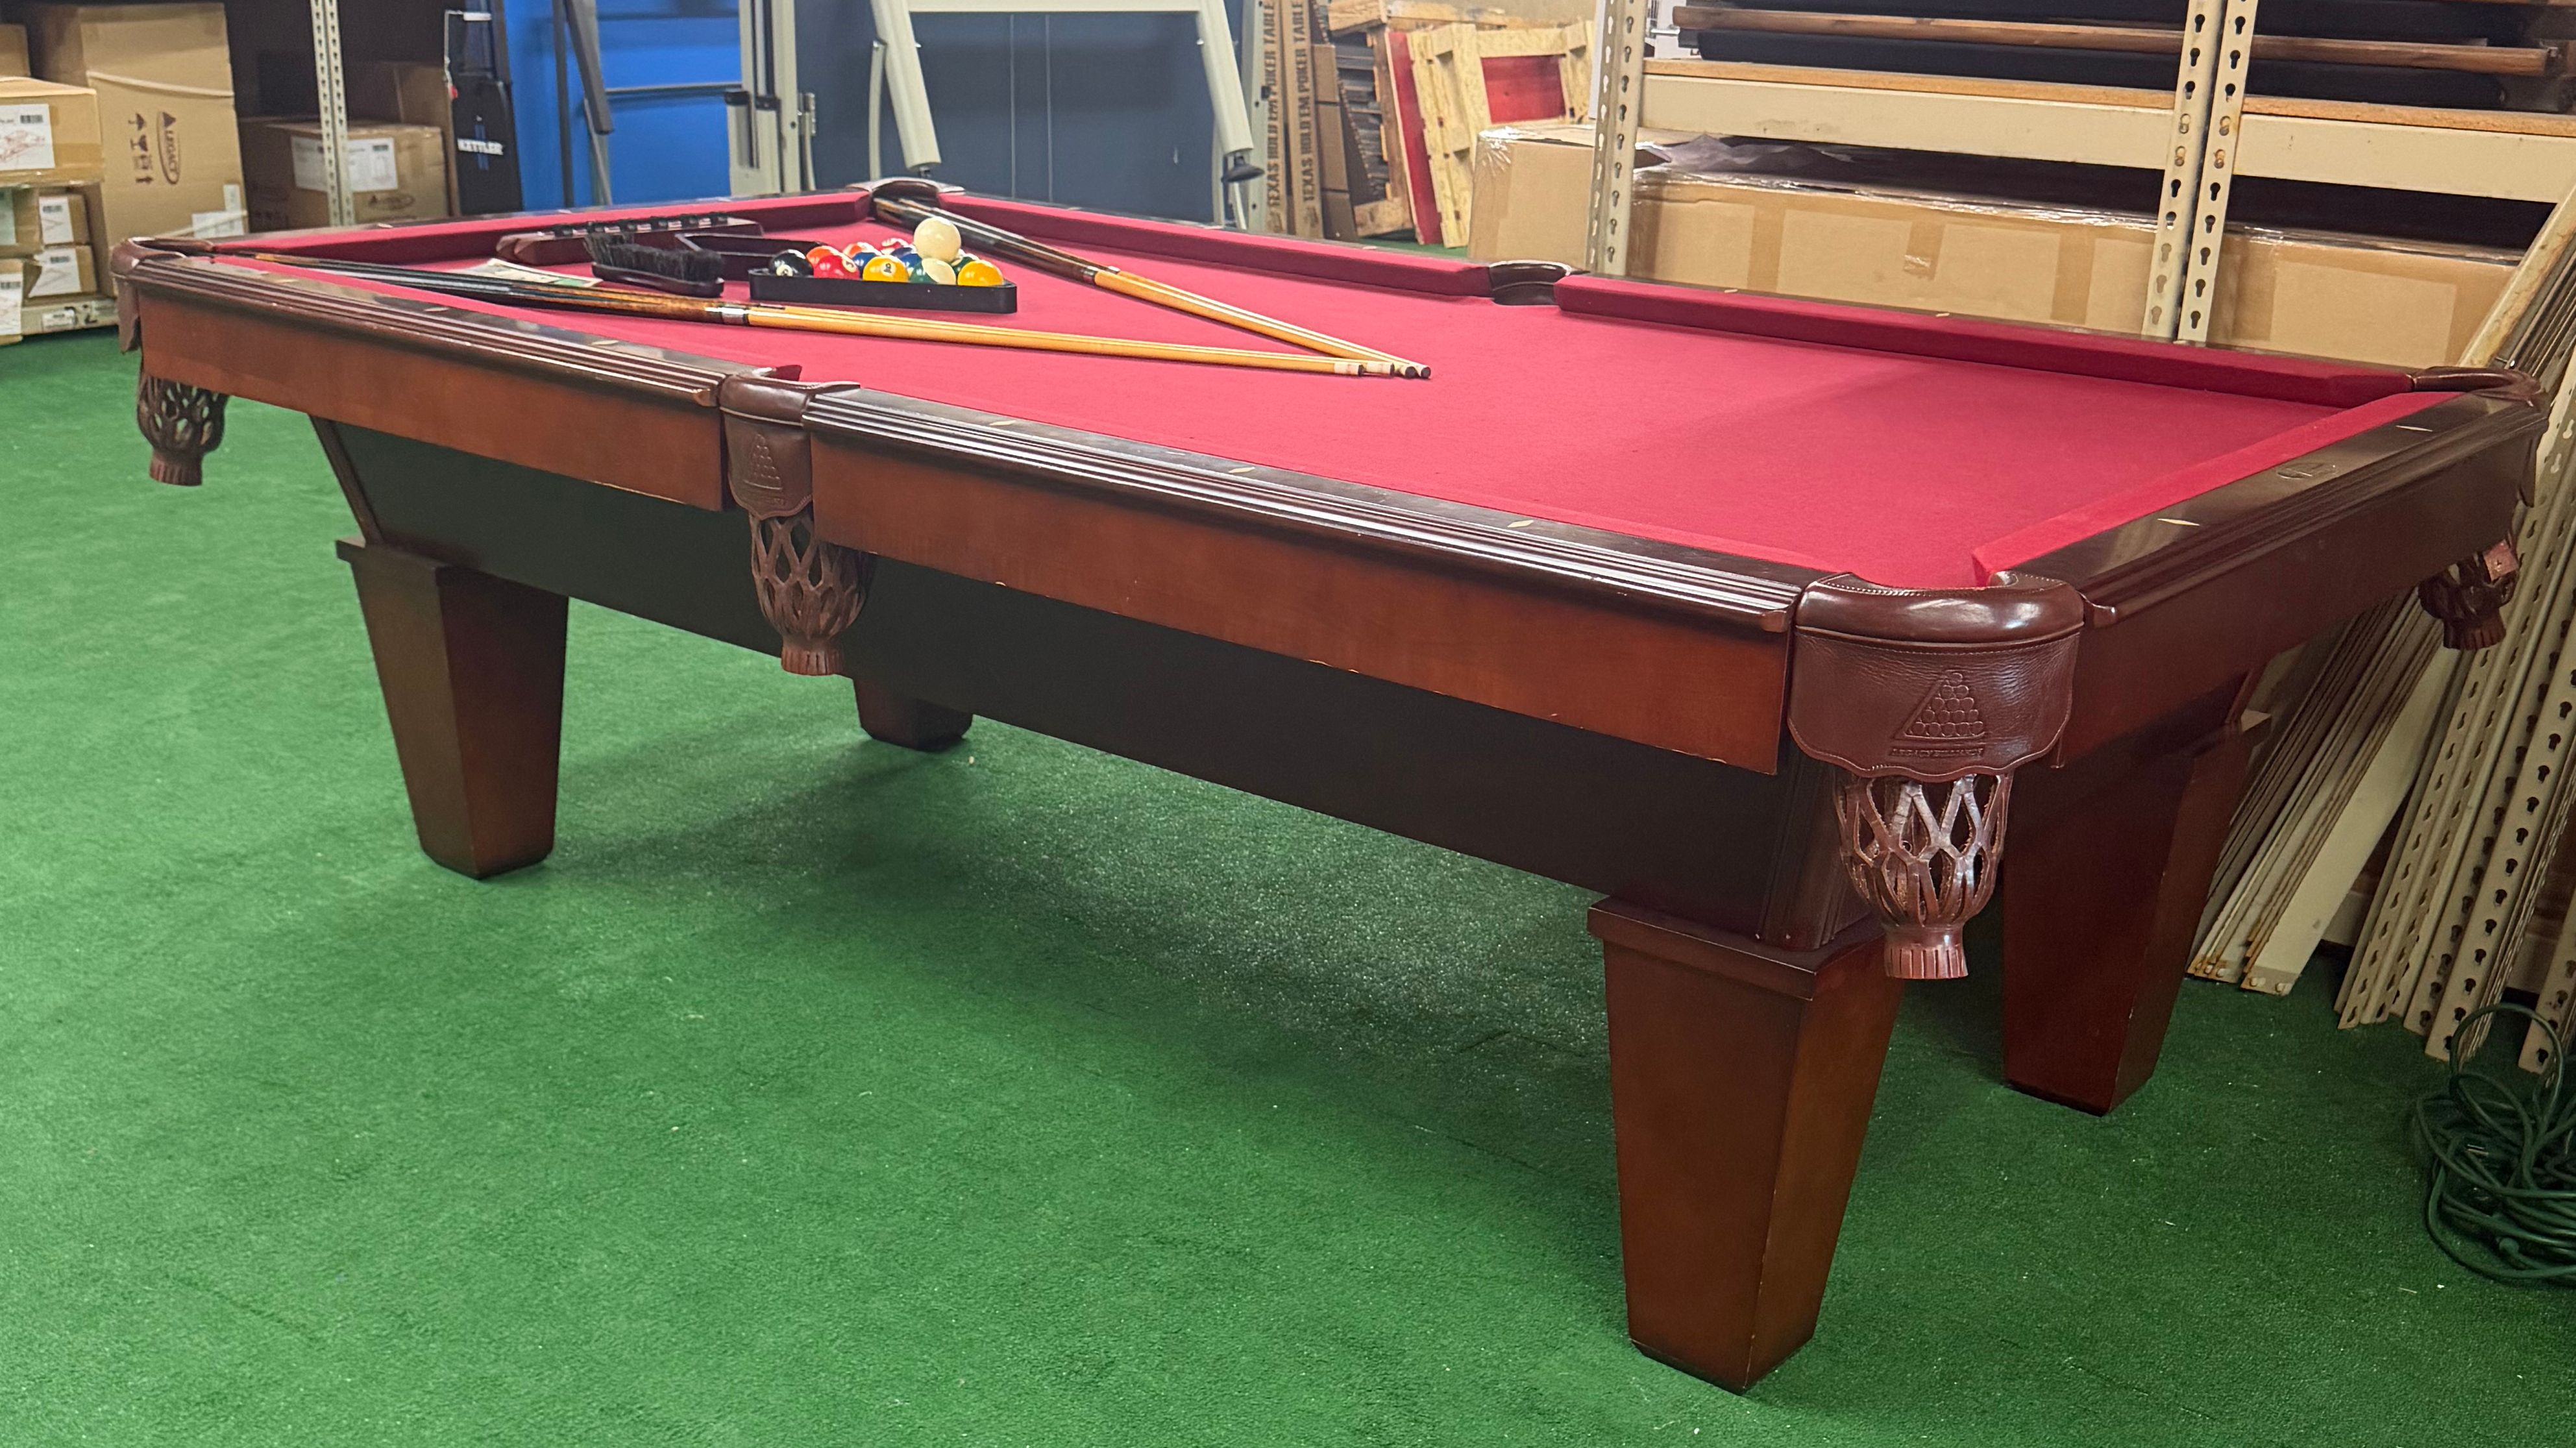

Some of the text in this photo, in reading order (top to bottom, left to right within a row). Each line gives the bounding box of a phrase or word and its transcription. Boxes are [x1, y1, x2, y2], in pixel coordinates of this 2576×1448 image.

[1263, 2, 1275, 44] TABLE
[1292, 1, 1305, 43] TABLE
[1295, 49, 1309, 93] POKER
[457, 138, 504, 155] KETTLER
[1267, 163, 1280, 206] TEXAS
[1301, 158, 1314, 202] TEXAS
